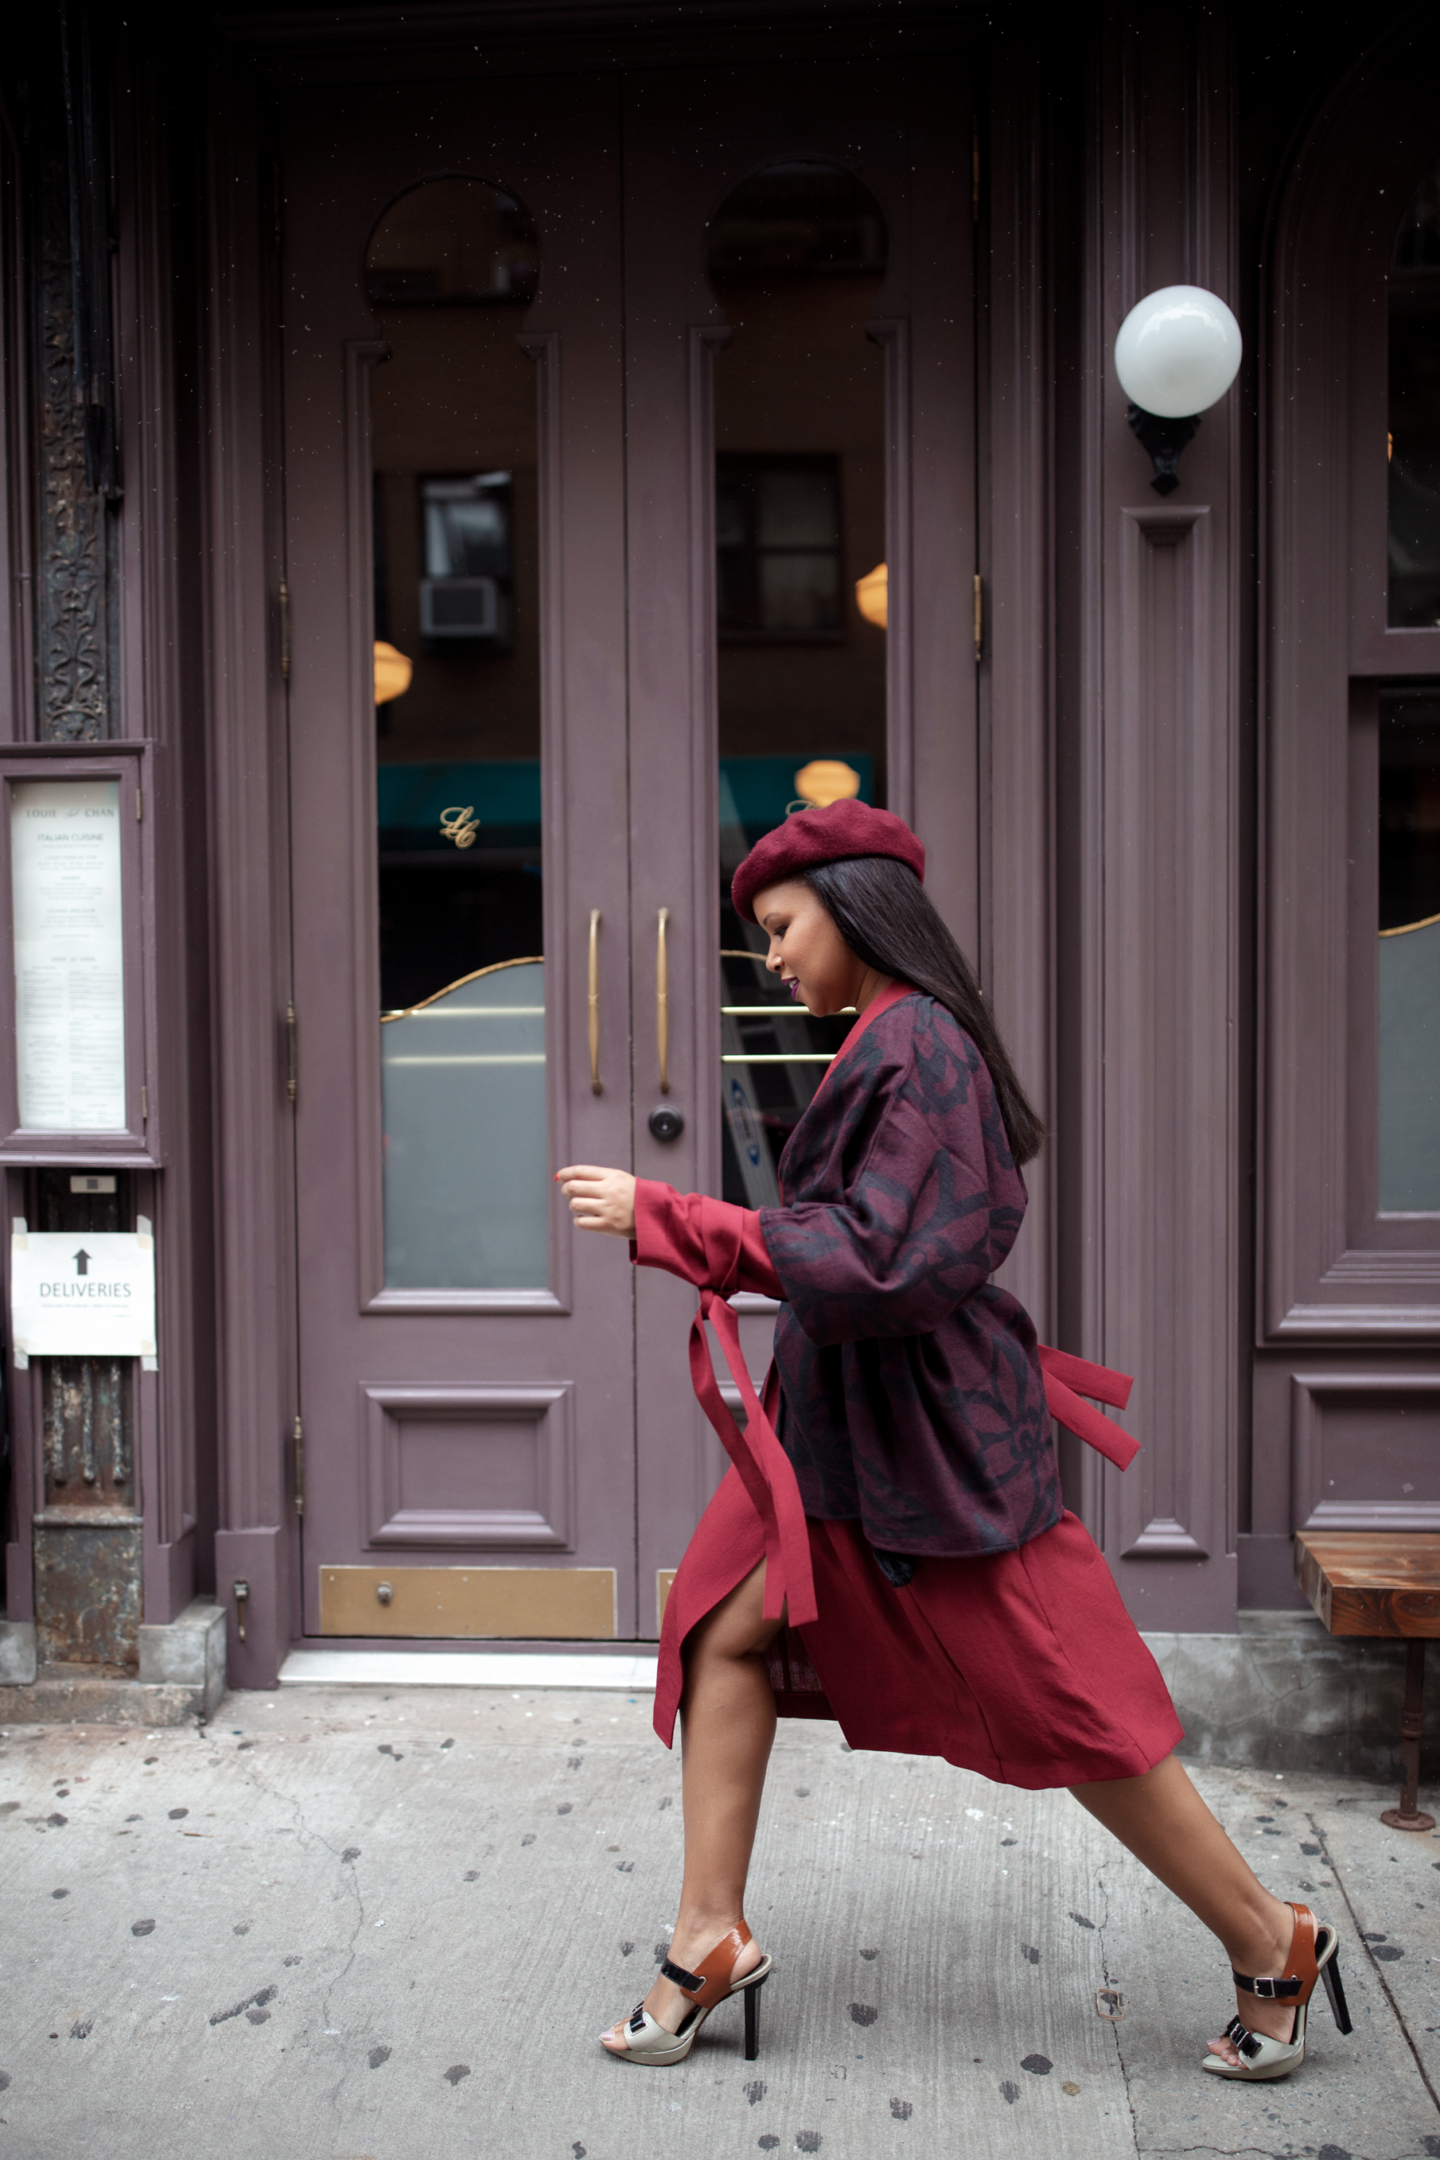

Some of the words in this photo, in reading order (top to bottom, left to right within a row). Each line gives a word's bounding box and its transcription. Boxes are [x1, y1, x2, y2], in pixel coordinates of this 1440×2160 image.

[26, 808, 57, 818] LOUIE
[84, 808, 115, 818] CHAN
[37, 833, 69, 841] ITALIAN
[71, 832, 104, 841] CUISINE
[40, 1282, 132, 1297] DELIVERIES
